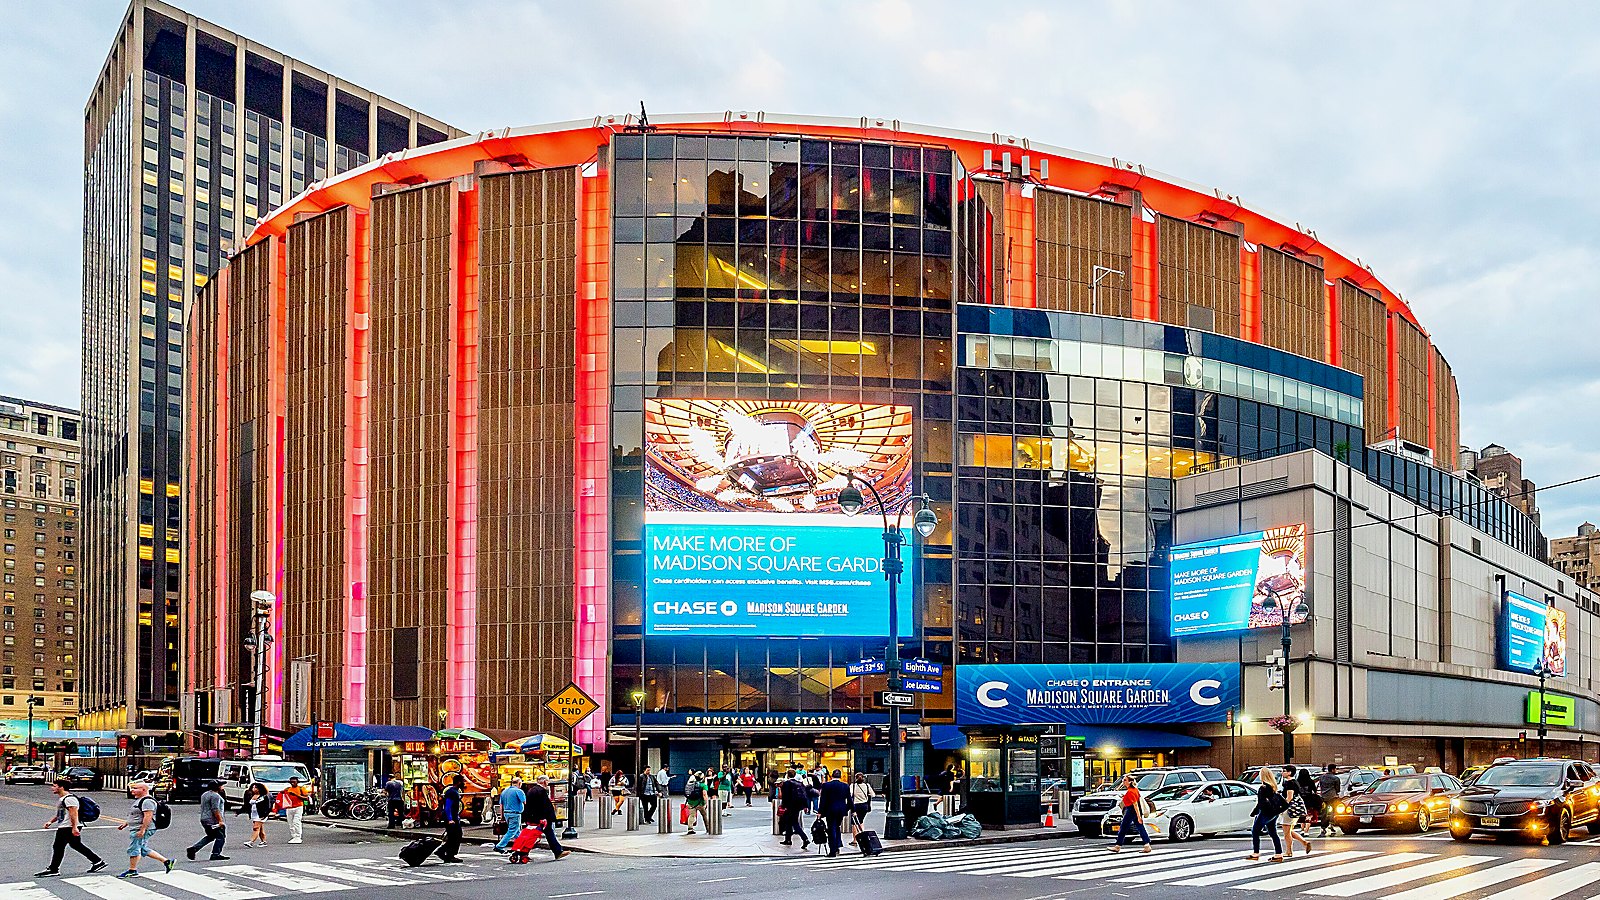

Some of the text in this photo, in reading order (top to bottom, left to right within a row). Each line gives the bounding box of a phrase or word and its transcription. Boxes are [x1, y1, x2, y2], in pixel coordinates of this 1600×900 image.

[653, 536, 797, 553] MAKE MORE OF
[653, 555, 887, 574] MADISON SQUARE GARDE
[1174, 571, 1191, 579] MAKE
[1191, 568, 1209, 576] MORE
[1174, 569, 1253, 586] MADISON SQUARE GARDEN
[653, 601, 718, 615] CHASE
[747, 601, 783, 614] MADISON
[785, 601, 816, 614] SQUARE
[1174, 612, 1201, 622] CHASE
[849, 665, 864, 673] West
[876, 662, 884, 671] St
[905, 662, 940, 673] Eighth Ave
[905, 681, 916, 689] Joe
[916, 681, 930, 690] Louis
[1046, 679, 1152, 687] CHASE ENTRANCE
[558, 697, 585, 706] DEAD
[1026, 689, 1077, 704] MADISON
[1080, 688, 1123, 704] SQUARE
[561, 707, 582, 715] END
[686, 716, 849, 725] PENNSYLVANIA STATION
[405, 742, 425, 752] HOT DOG
[436, 741, 477, 751] ALAFEL
